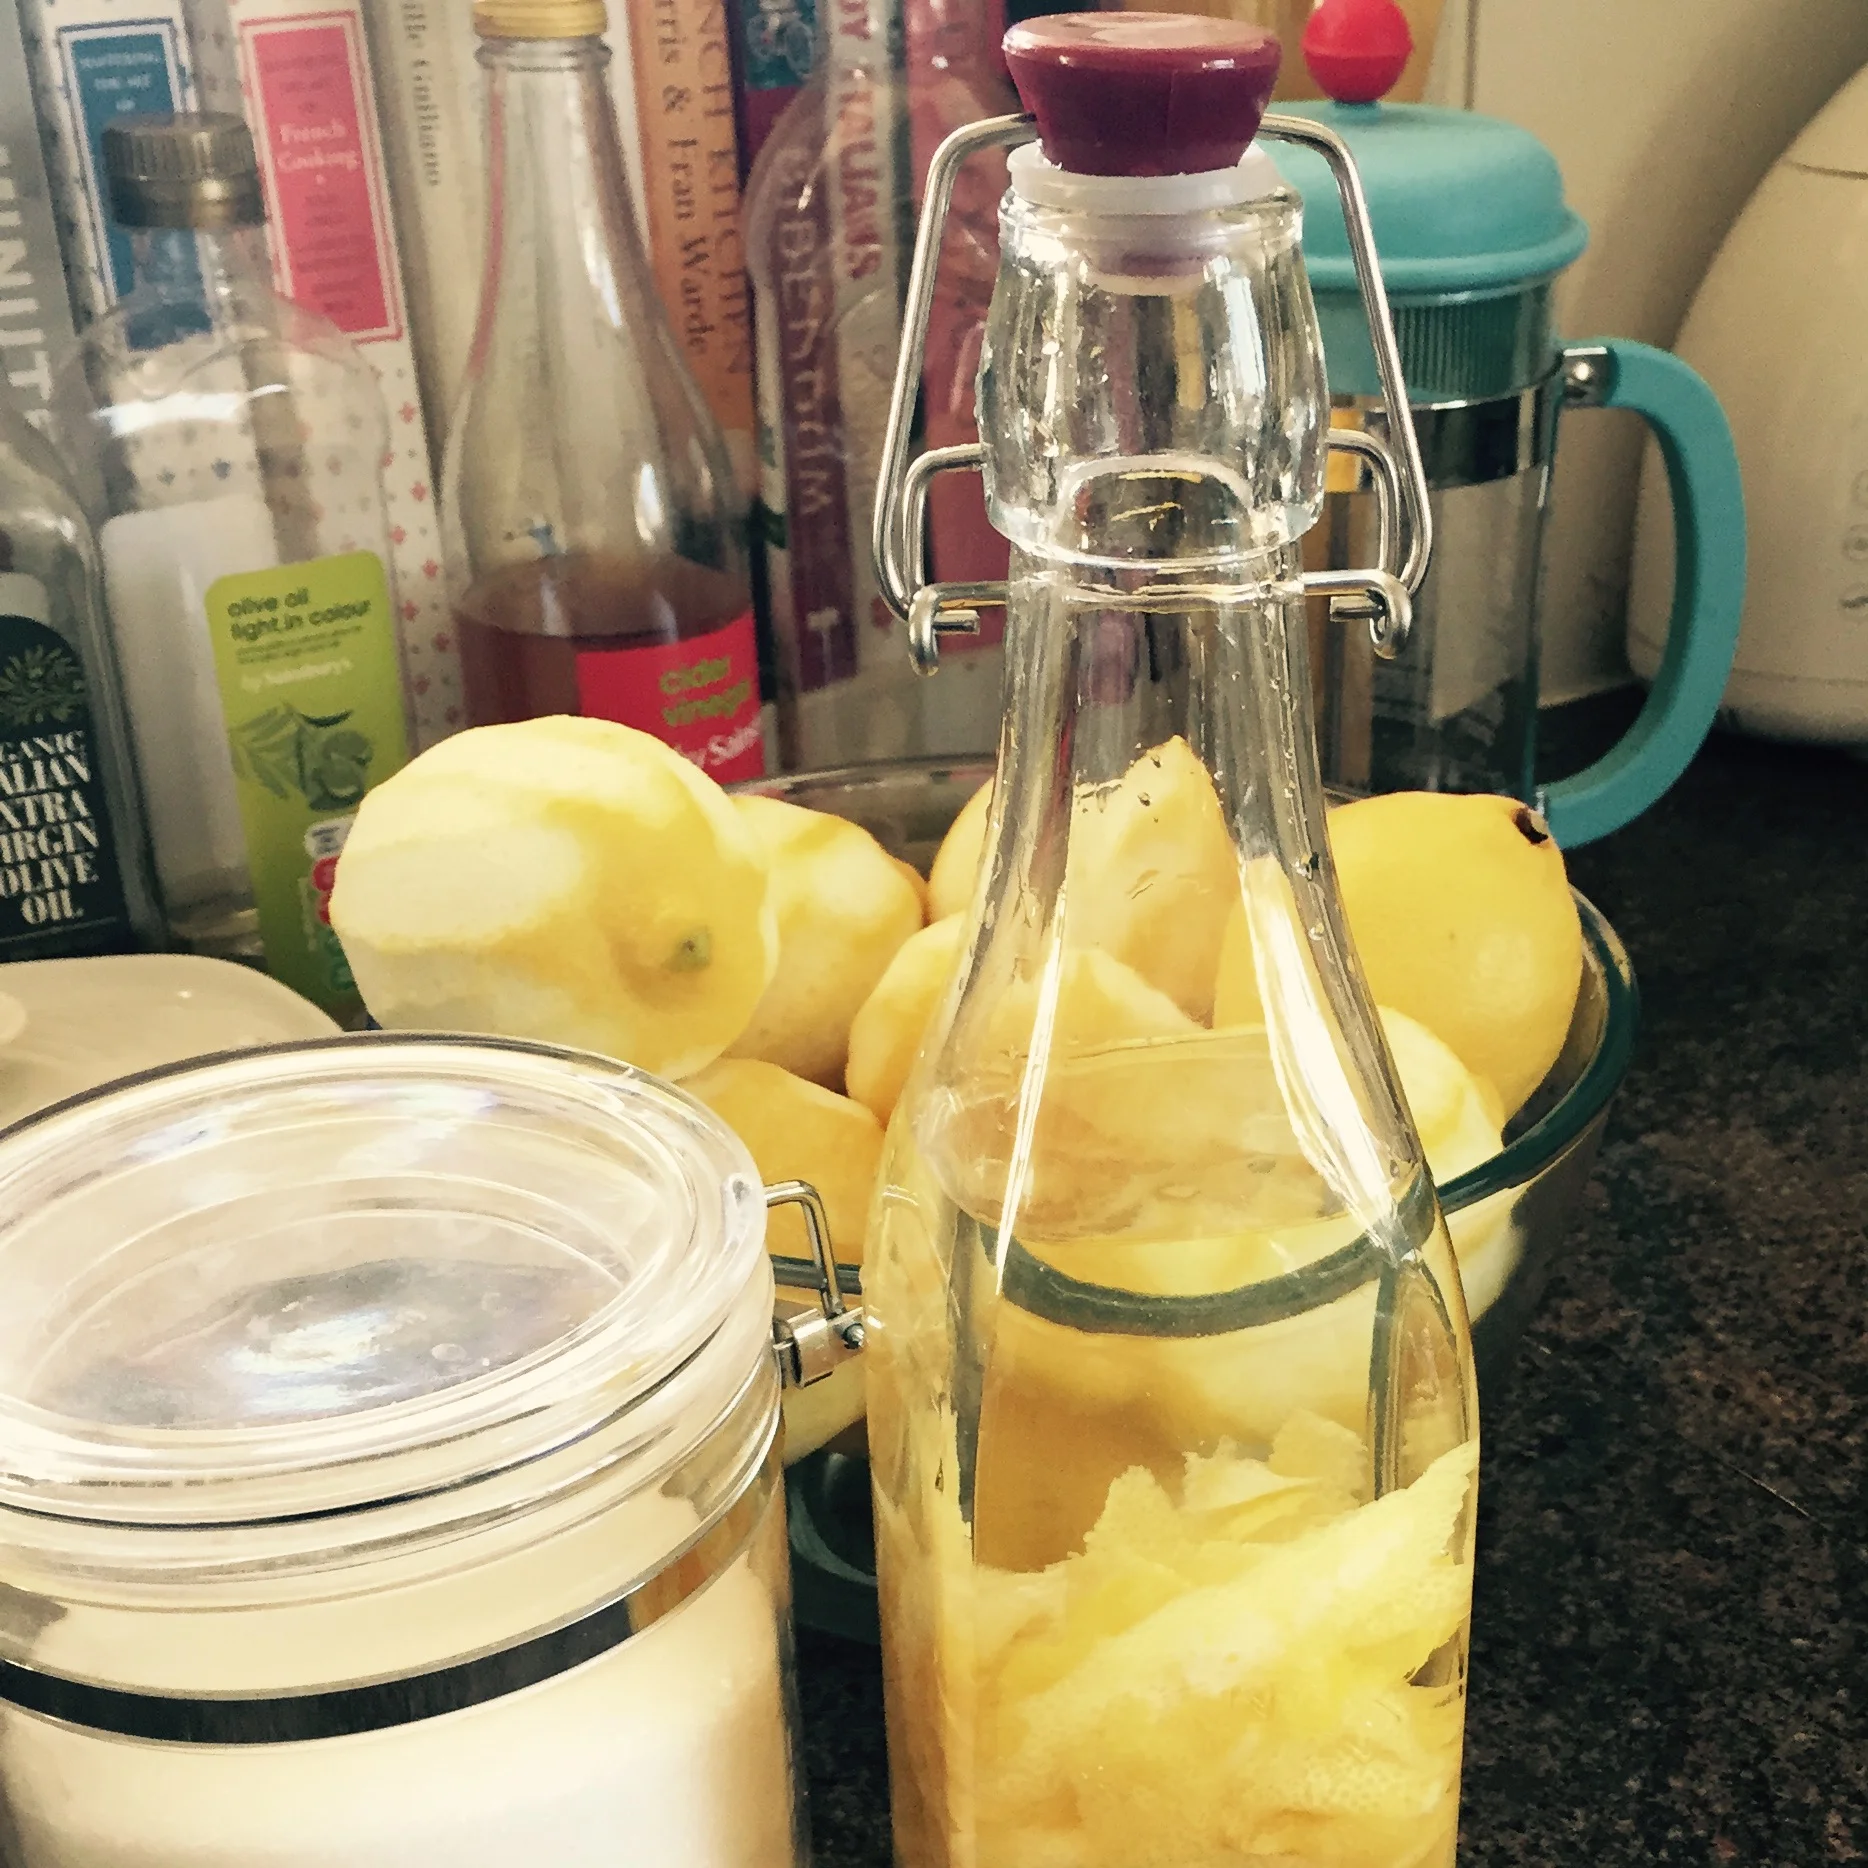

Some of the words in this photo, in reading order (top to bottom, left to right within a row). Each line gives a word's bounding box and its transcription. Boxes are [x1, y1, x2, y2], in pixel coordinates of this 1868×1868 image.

[667, 138, 699, 221] Fran
[227, 596, 278, 618] olive
[284, 586, 309, 608] oil
[231, 616, 280, 641] light
[308, 599, 372, 626] colour
[21, 888, 85, 925] OIL
